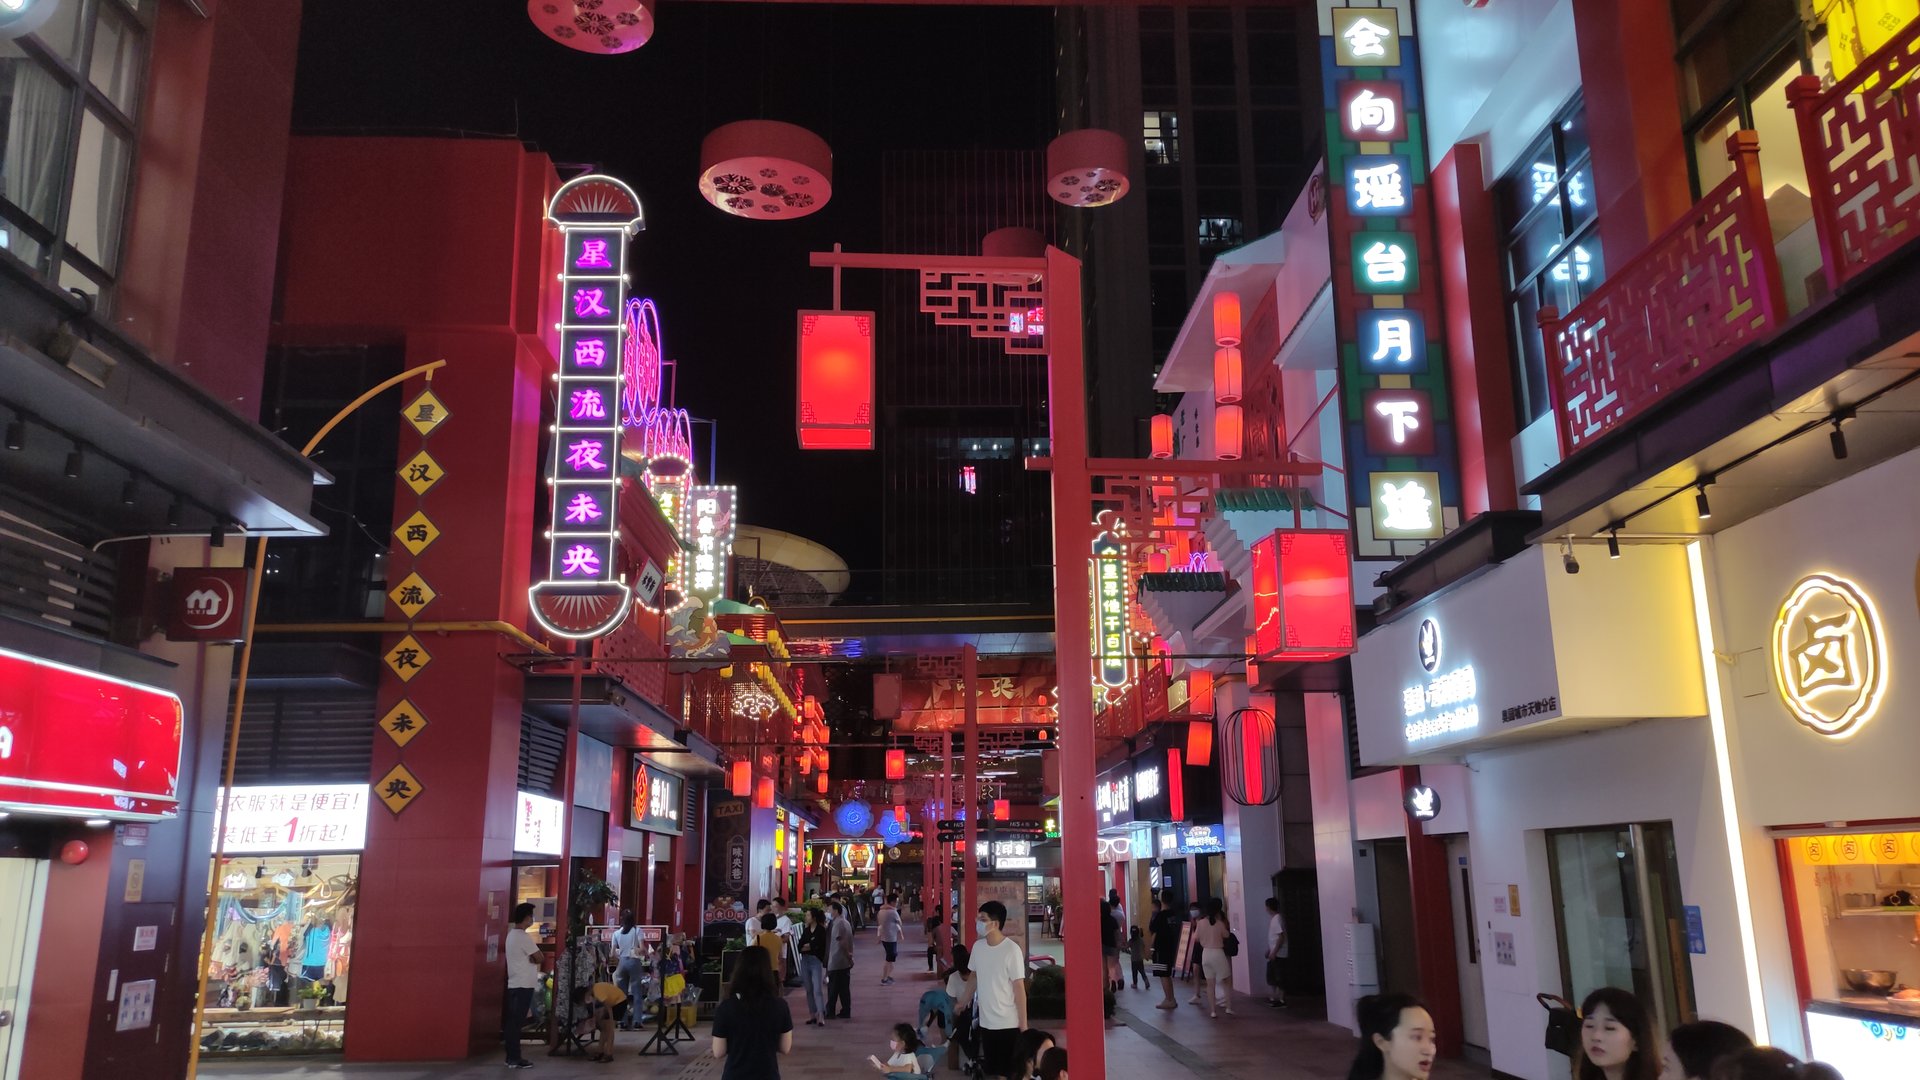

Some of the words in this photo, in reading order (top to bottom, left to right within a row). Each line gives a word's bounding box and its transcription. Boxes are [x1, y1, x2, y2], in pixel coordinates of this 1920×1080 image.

[1342, 17, 1432, 530] 会向瑶台月下逢
[562, 239, 612, 577] 星汉西流夜未央
[385, 404, 439, 800] 星汉西流夜未央
[1790, 612, 1853, 698] 卤
[211, 817, 347, 844] 装低至1折起!
[717, 804, 743, 815] TAXI
